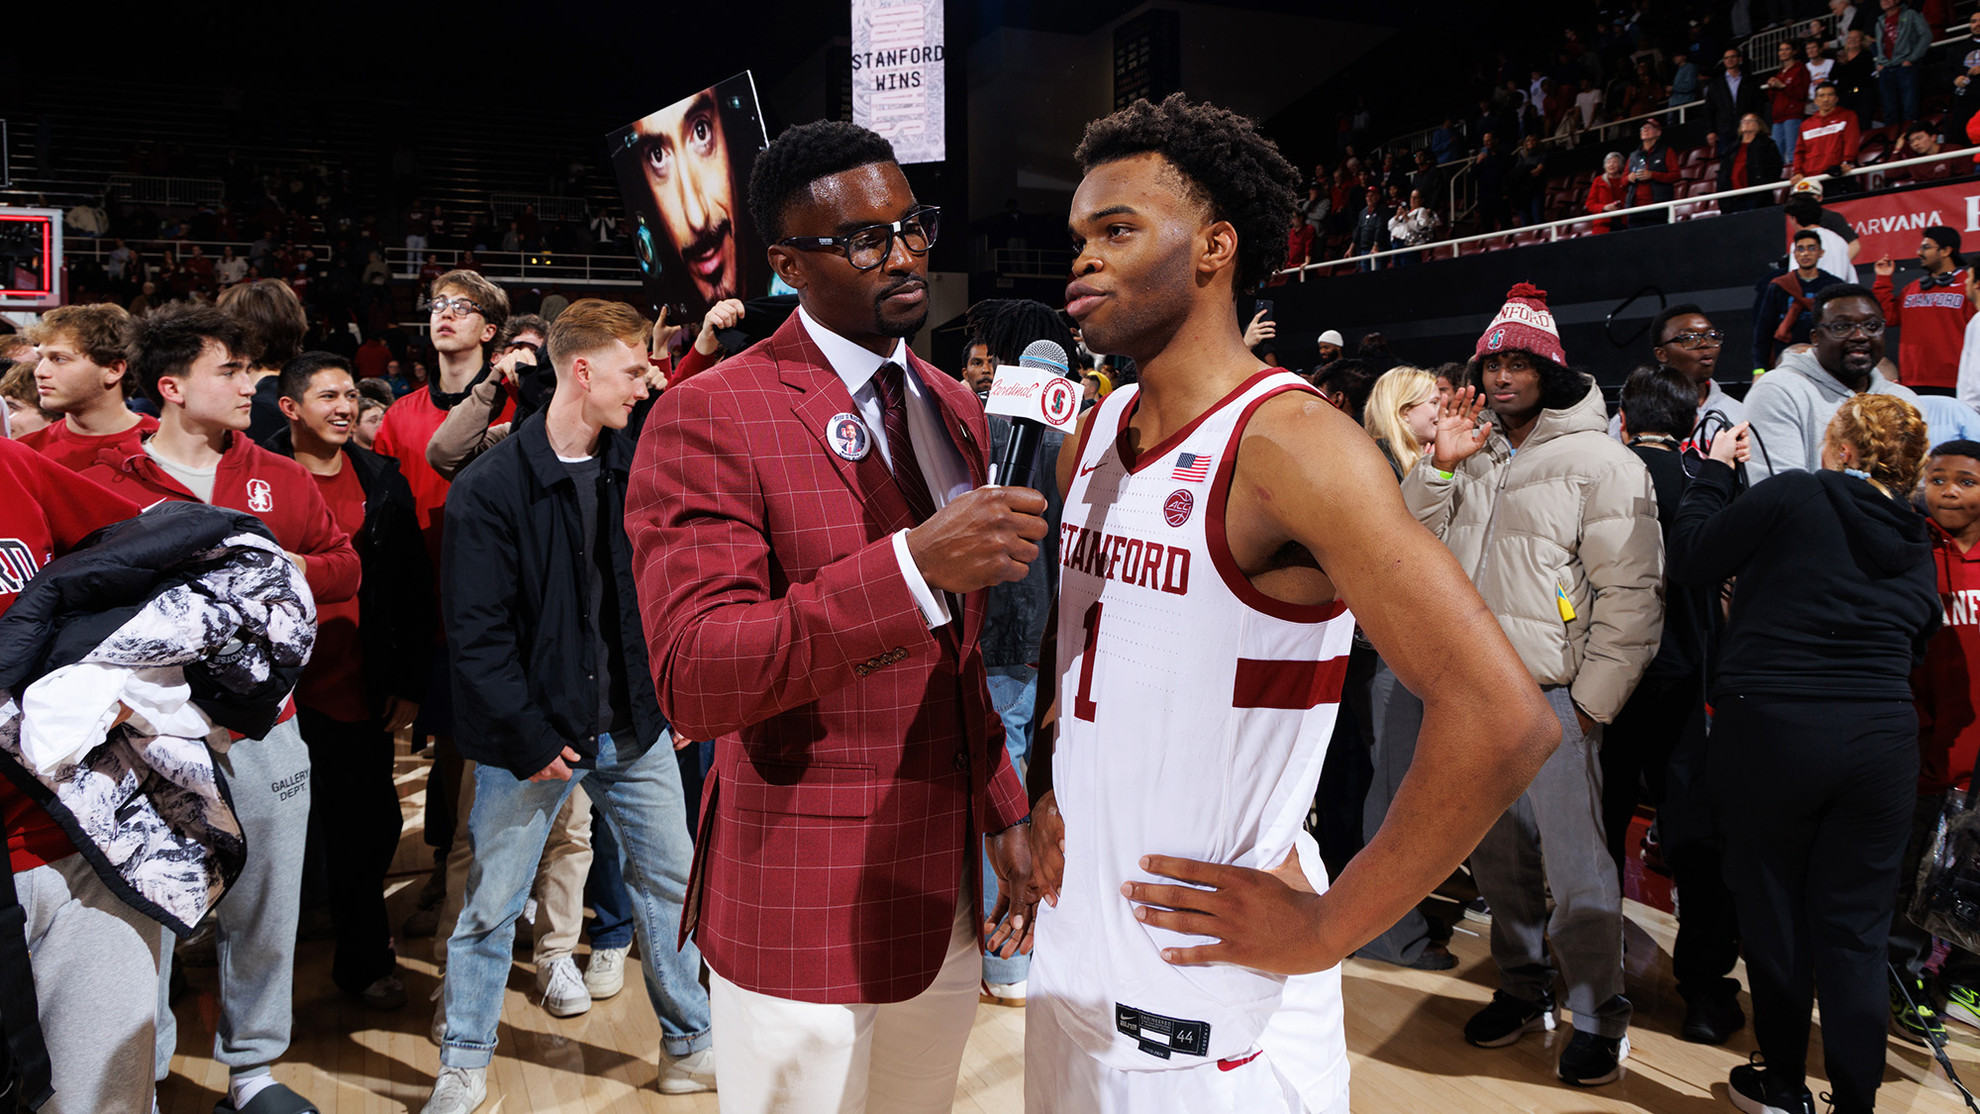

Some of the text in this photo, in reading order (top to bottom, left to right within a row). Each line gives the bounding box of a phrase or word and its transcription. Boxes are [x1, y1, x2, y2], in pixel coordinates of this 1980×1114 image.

[852, 45, 944, 70] STANFORD
[876, 71, 921, 91] WINS
[1848, 209, 1943, 235] ARVANA
[1904, 293, 1964, 308] STANFORD
[1168, 501, 1191, 511] ACC
[1074, 601, 1103, 722] 1
[271, 768, 309, 793] GALLERY
[280, 782, 307, 801] DEPT.
[1176, 1030, 1193, 1044] 44
